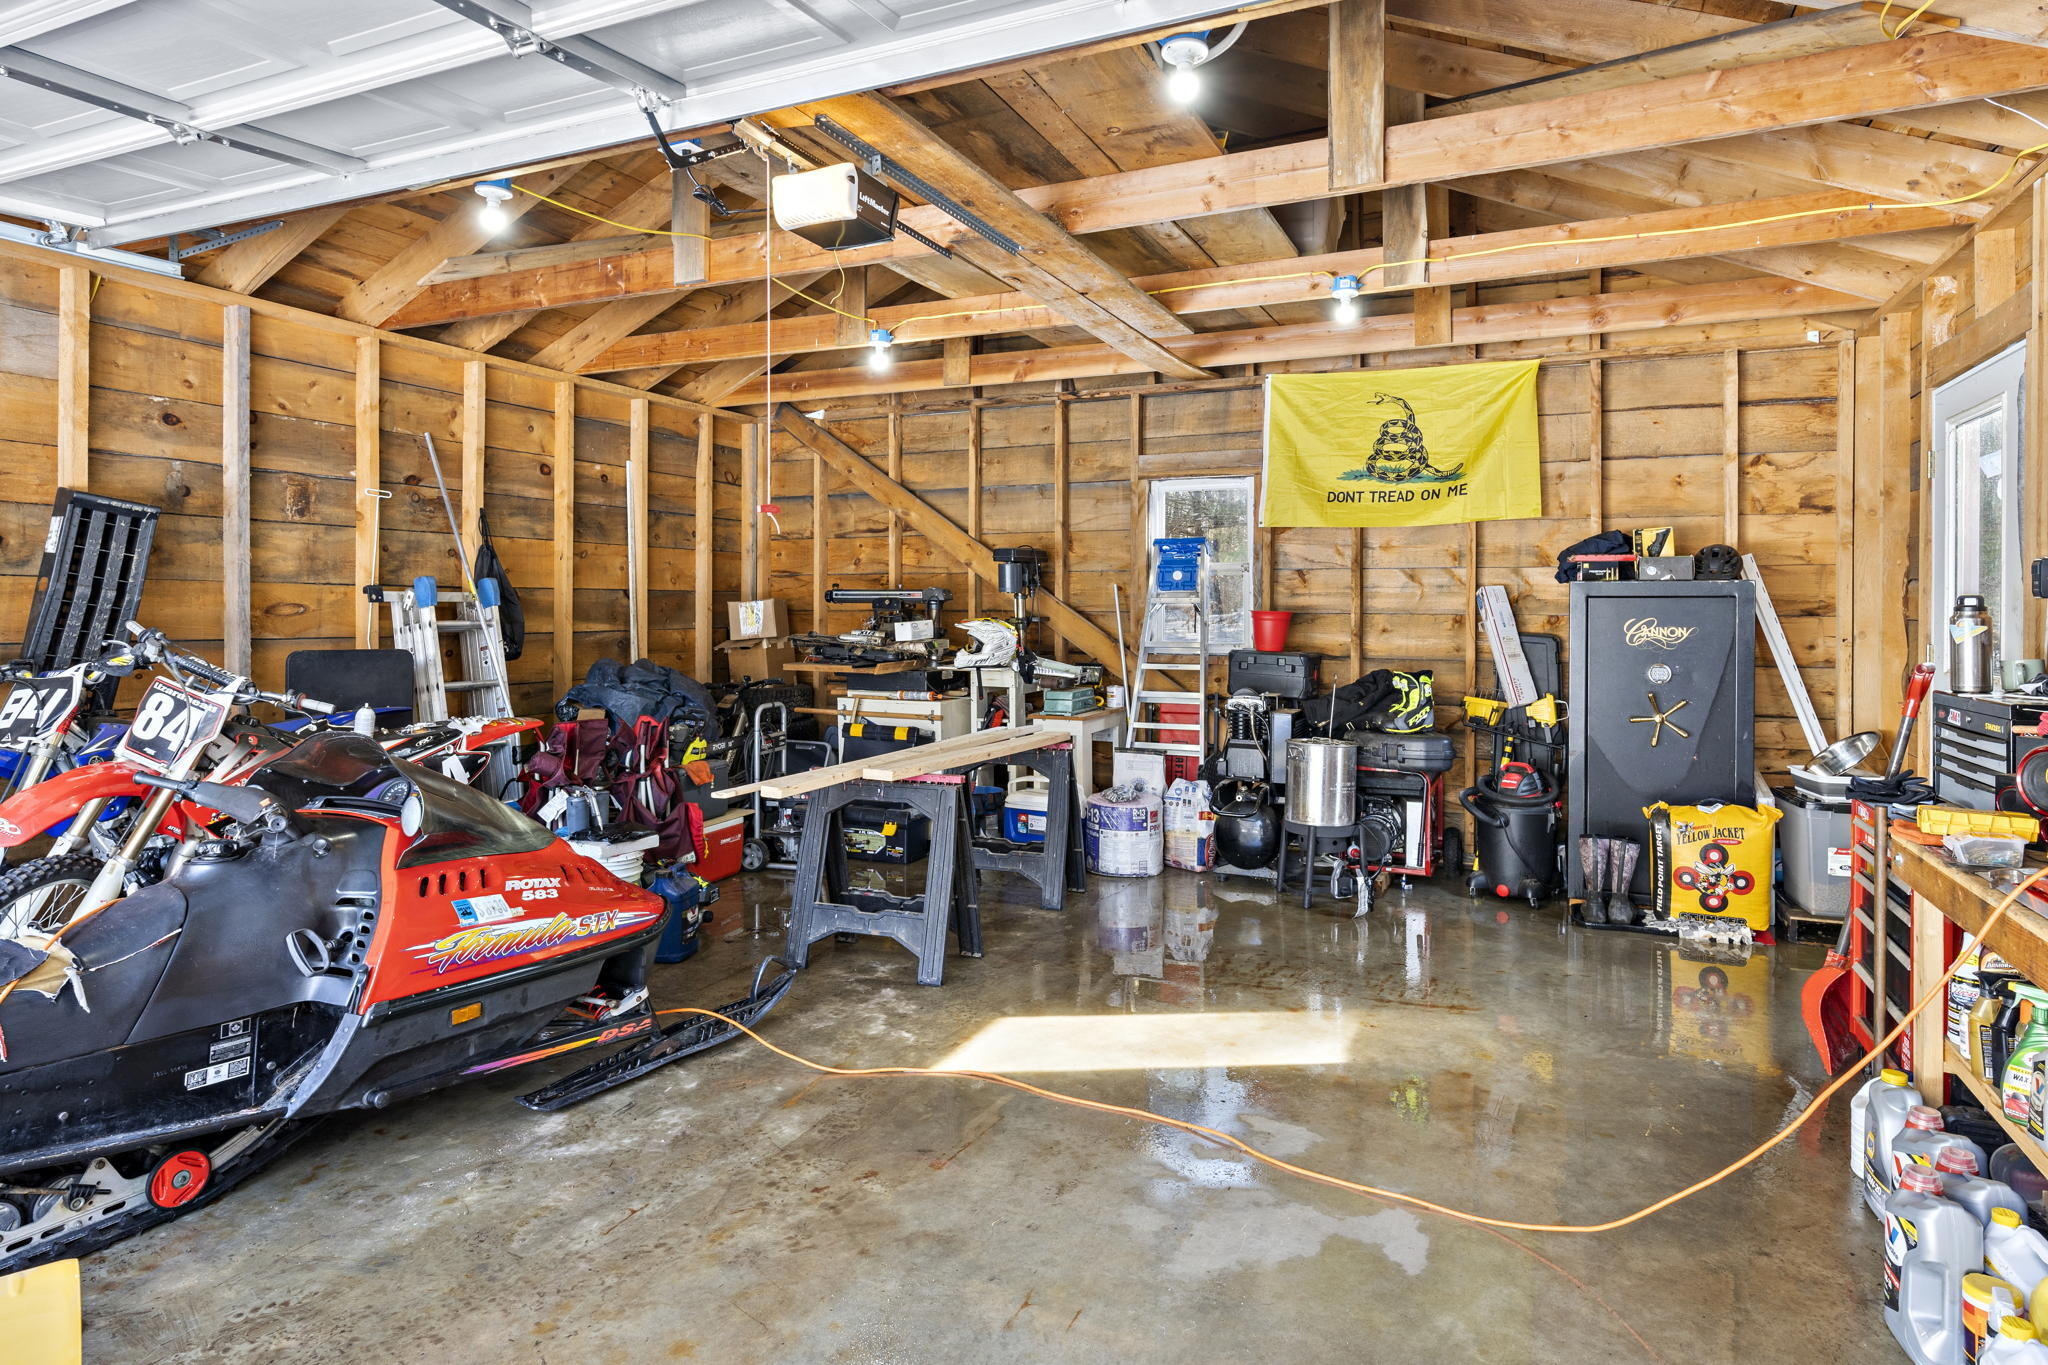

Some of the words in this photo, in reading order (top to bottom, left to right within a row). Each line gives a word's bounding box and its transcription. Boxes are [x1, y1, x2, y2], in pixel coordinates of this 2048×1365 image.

[859, 191, 890, 216] LiftMaster
[1327, 491, 1365, 503] DONT
[1369, 490, 1415, 503] TREAD
[1420, 488, 1441, 501] ON
[1447, 483, 1469, 497] ME
[131, 692, 207, 752] 84
[1133, 808, 1146, 816] R-13
[1655, 823, 1663, 857] TARGET
[1677, 829, 1710, 845] YELLOW
[1712, 827, 1745, 840] JACKET
[505, 877, 561, 892] ROTAX
[521, 889, 559, 901] 583
[1656, 888, 1664, 912] FIELD
[428, 911, 577, 974] Formula
[576, 909, 620, 938] STX
[2013, 1073, 2029, 1084] WAX
